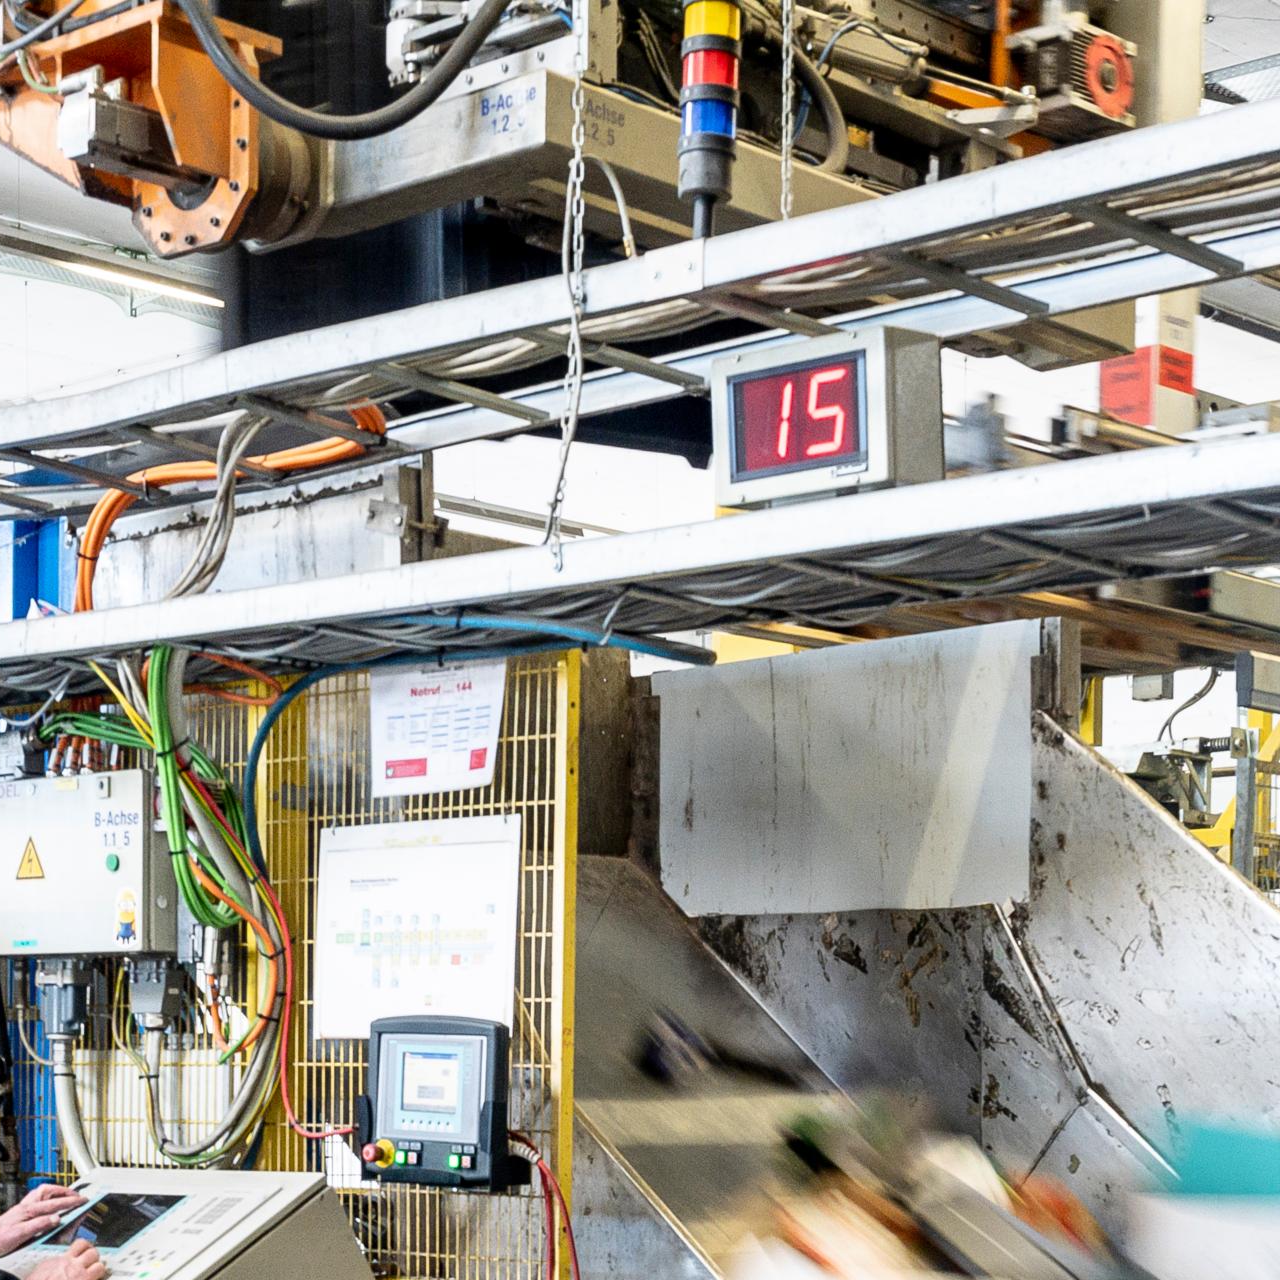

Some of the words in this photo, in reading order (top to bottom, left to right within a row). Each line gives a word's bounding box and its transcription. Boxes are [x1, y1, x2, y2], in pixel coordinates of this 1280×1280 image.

[778, 367, 848, 458] 15
[410, 684, 441, 697] Notruf
[456, 681, 472, 692] 144
[94, 810, 139, 828] B-Achse
